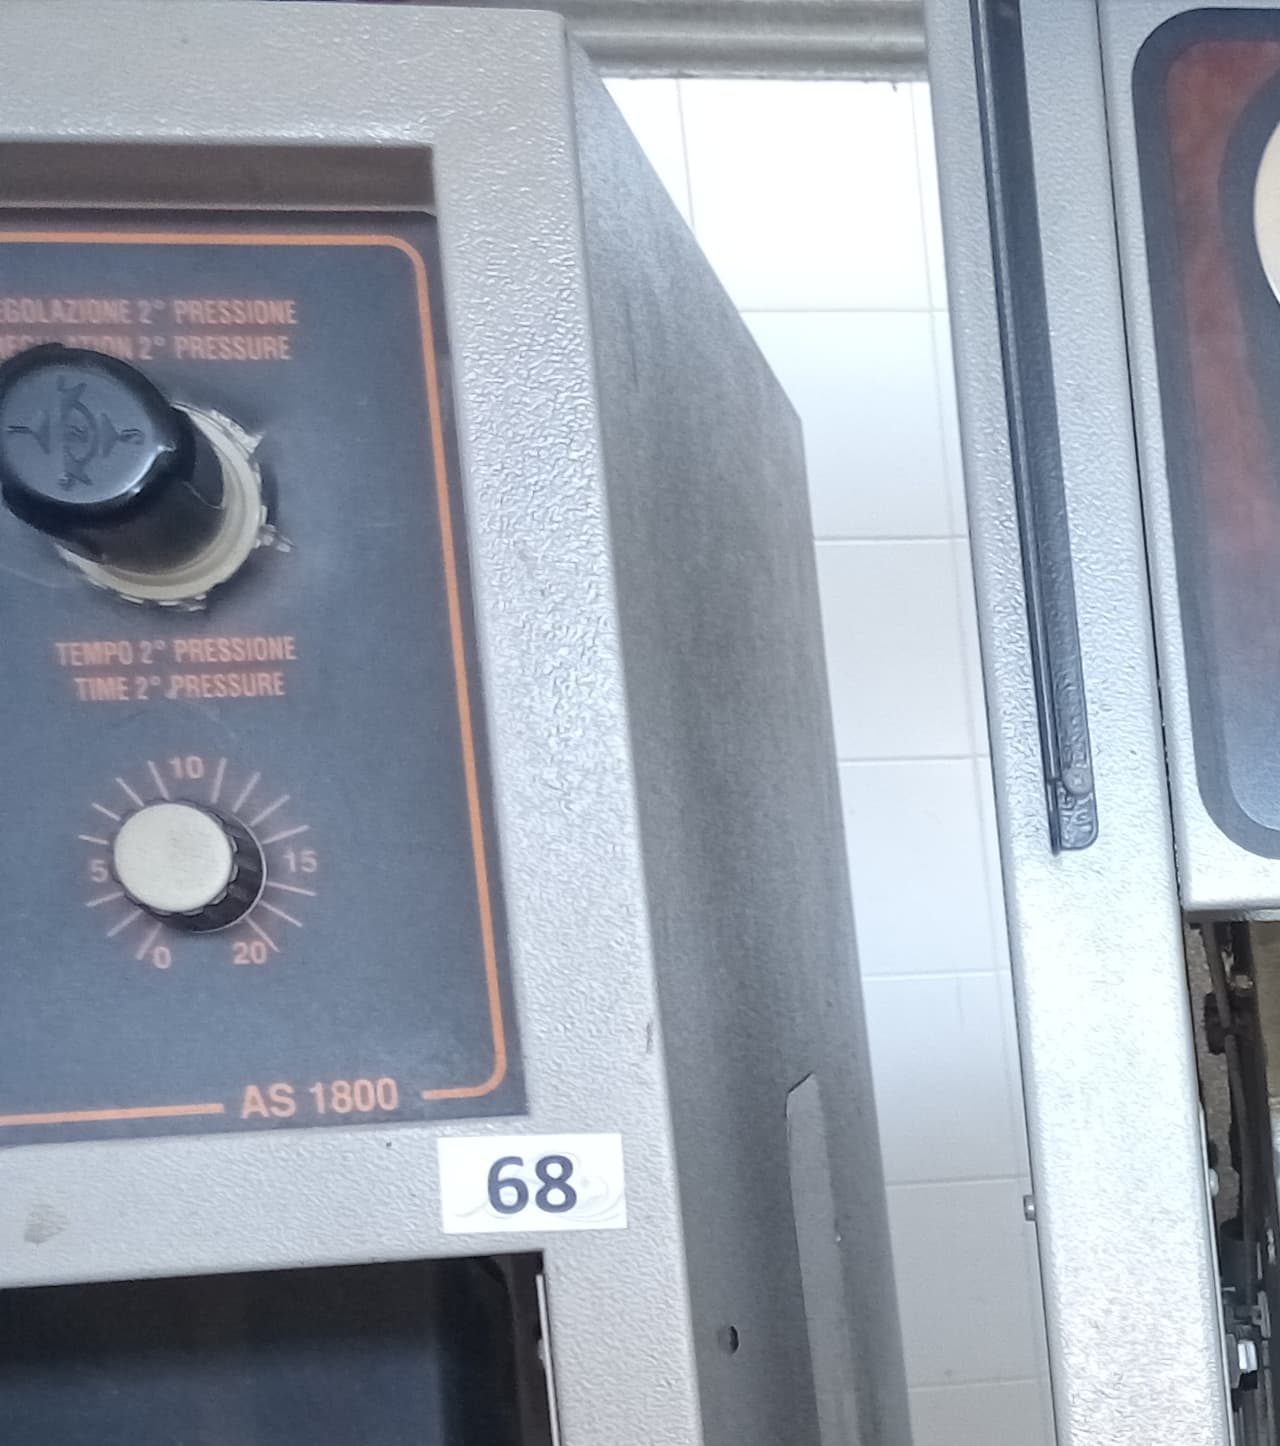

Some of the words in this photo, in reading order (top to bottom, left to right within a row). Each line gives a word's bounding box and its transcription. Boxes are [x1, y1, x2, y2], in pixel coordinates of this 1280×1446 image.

[174, 299, 297, 325] PRESSIONE
[173, 335, 292, 361] PRESSURE
[55, 641, 134, 667] TEMPO
[173, 636, 297, 664] PRESSIONE
[74, 677, 129, 700] TIME
[170, 672, 286, 699] PRESSURE
[169, 756, 204, 779] 10
[90, 859, 109, 883] 5
[284, 850, 318, 873] 15
[152, 945, 172, 969] 0
[232, 941, 267, 965] 20
[240, 1084, 297, 1120] AS
[309, 1077, 399, 1115] 1800
[487, 1154, 578, 1215] 68
